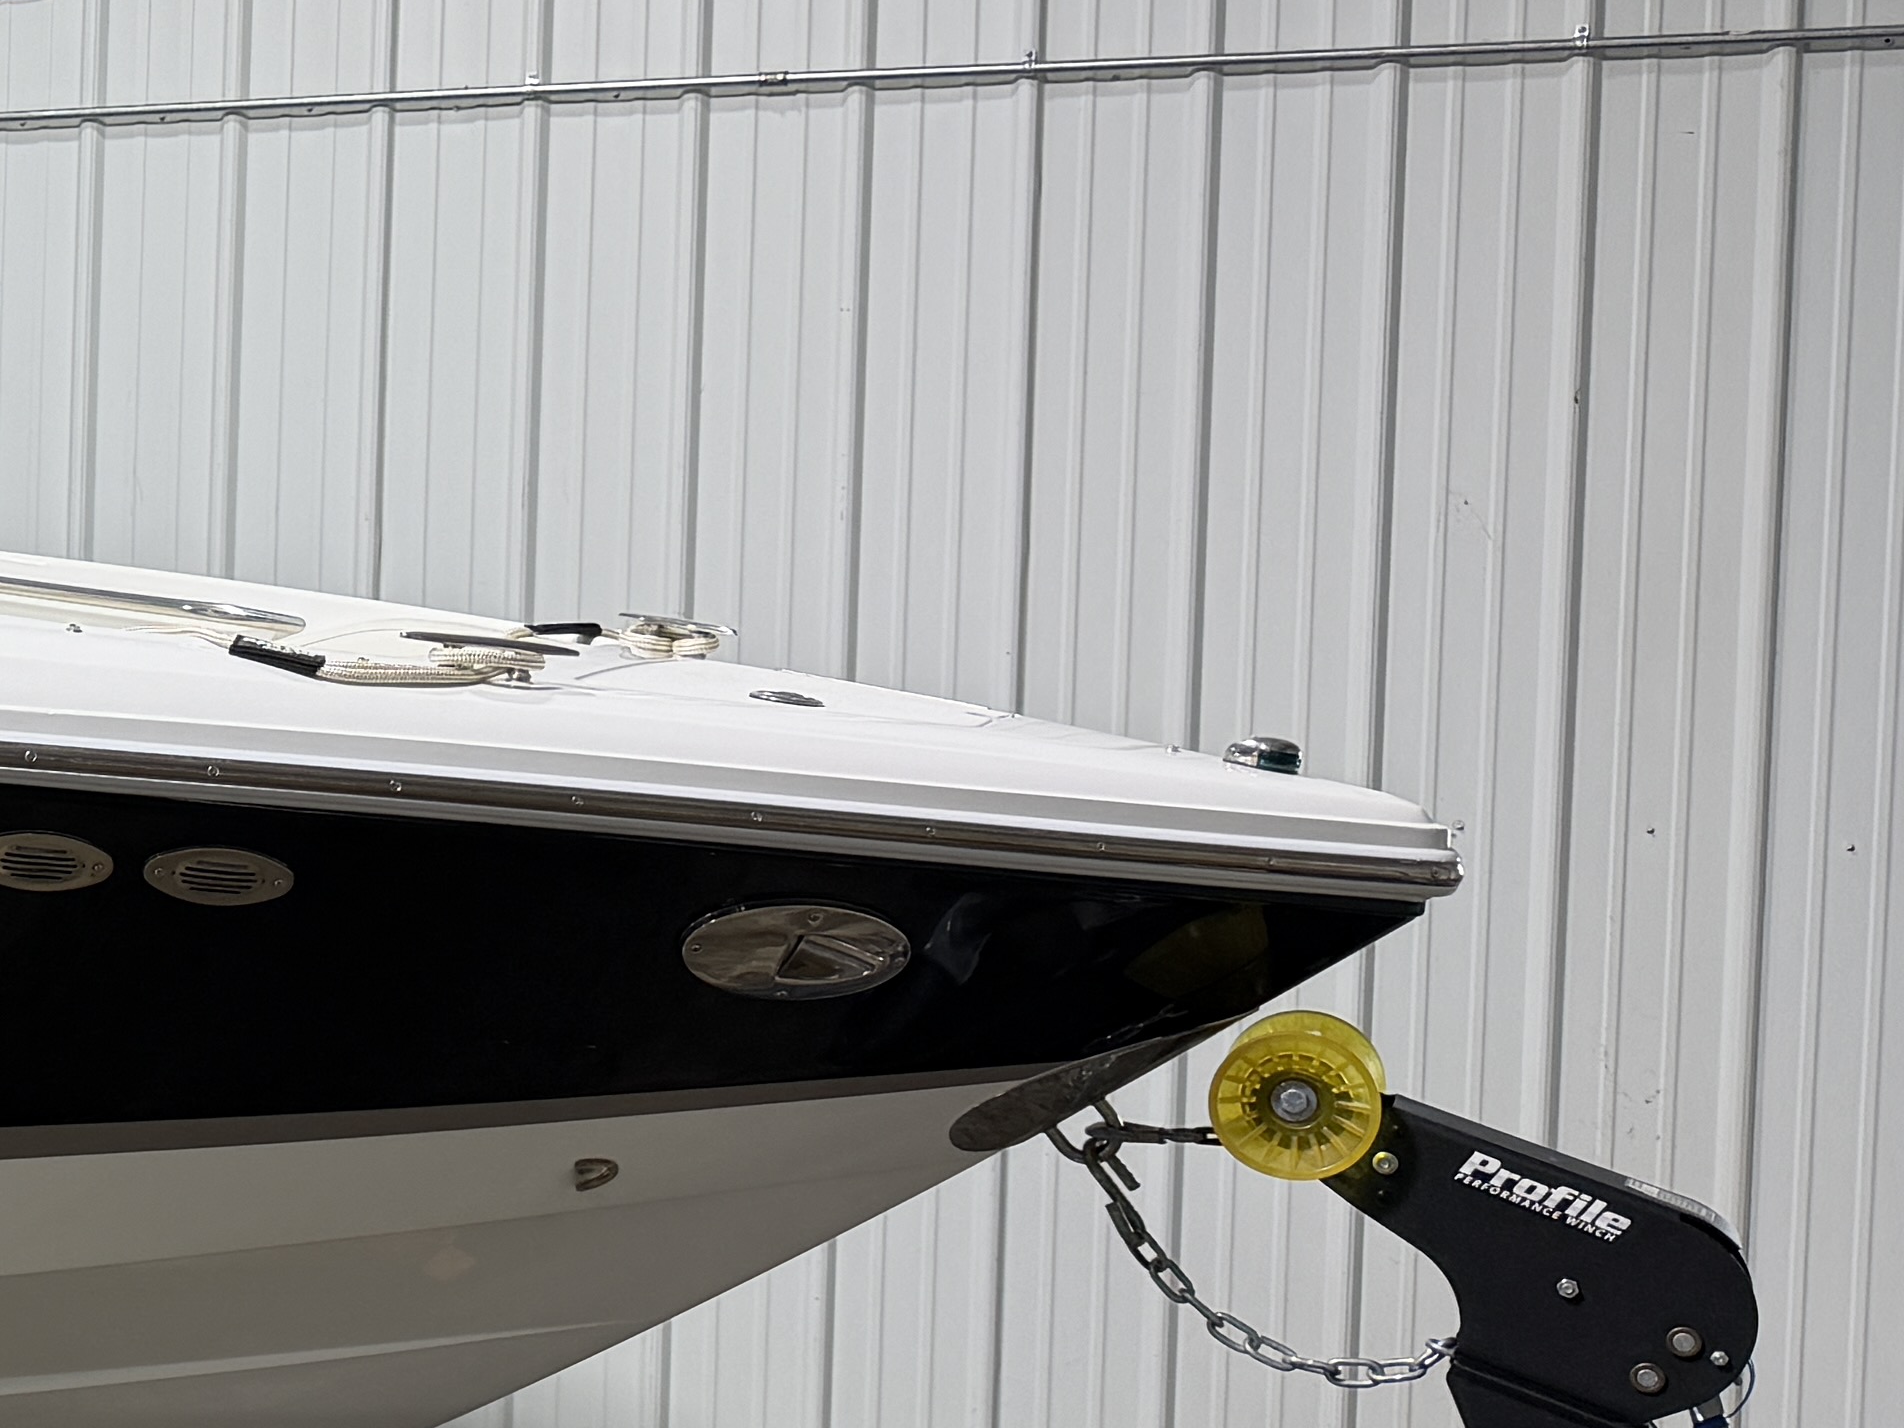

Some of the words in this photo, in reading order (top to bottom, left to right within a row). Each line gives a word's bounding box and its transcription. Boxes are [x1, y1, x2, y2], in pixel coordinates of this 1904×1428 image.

[1453, 1172, 1562, 1221] PERFORMANCE
[1564, 1215, 1618, 1243] WINCH
[1458, 1150, 1632, 1236] Profile
